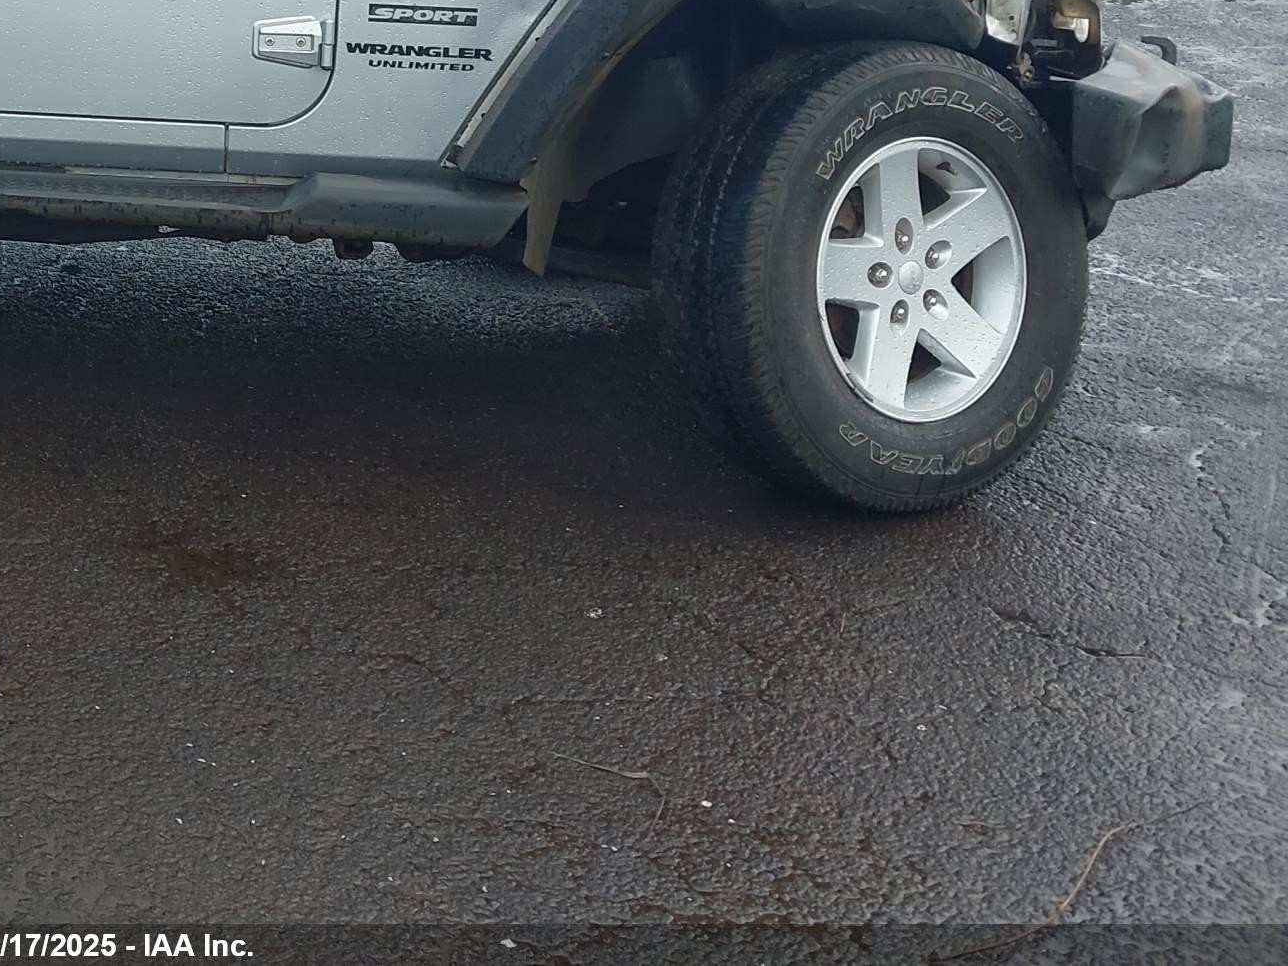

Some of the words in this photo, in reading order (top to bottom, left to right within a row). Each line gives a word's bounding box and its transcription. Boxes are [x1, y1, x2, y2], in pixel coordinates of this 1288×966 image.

[368, 5, 478, 24] SPORT
[345, 42, 494, 62] WRANGLER
[368, 59, 475, 72] UNLIMITED
[815, 86, 1024, 181] WRANGLER
[838, 364, 1054, 475] GOODYEAR
